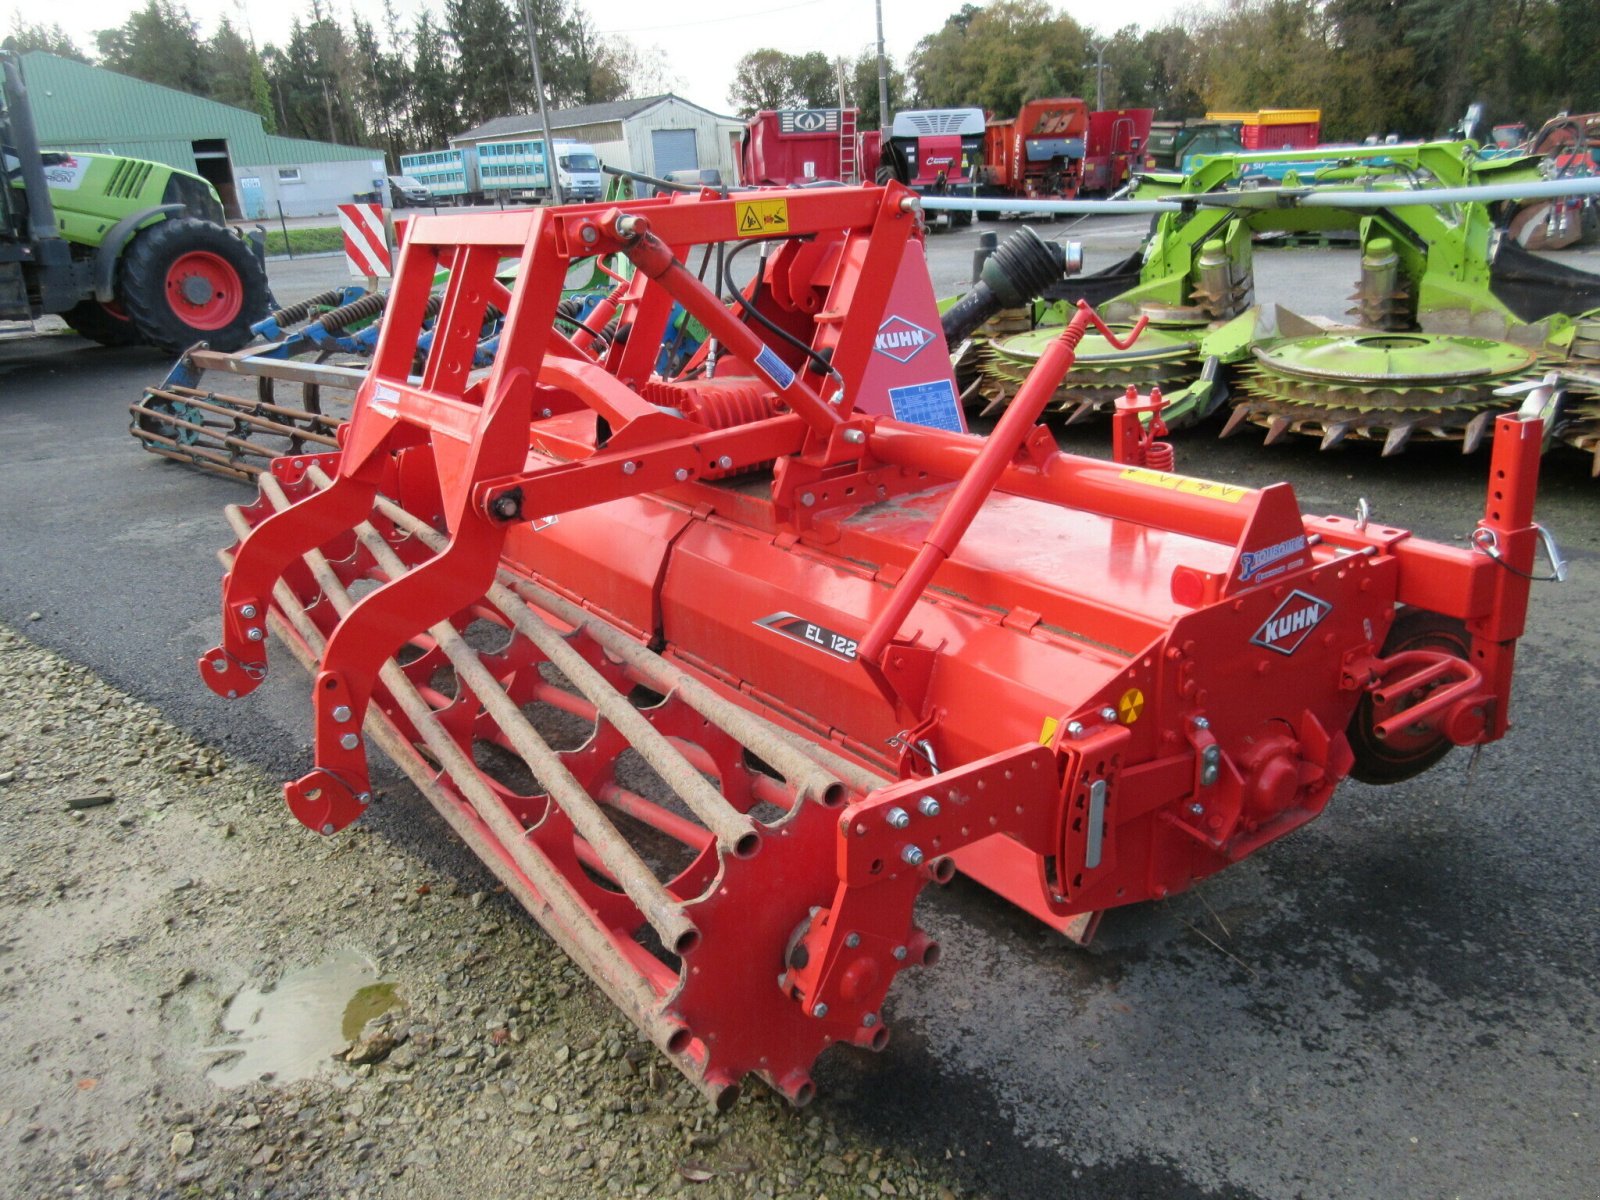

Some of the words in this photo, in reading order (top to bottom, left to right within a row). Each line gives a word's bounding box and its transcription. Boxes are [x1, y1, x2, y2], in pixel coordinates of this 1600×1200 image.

[875, 329, 925, 350] KUHN
[805, 623, 824, 645] EL
[830, 634, 858, 658] 122
[1265, 604, 1319, 644] KUHN
